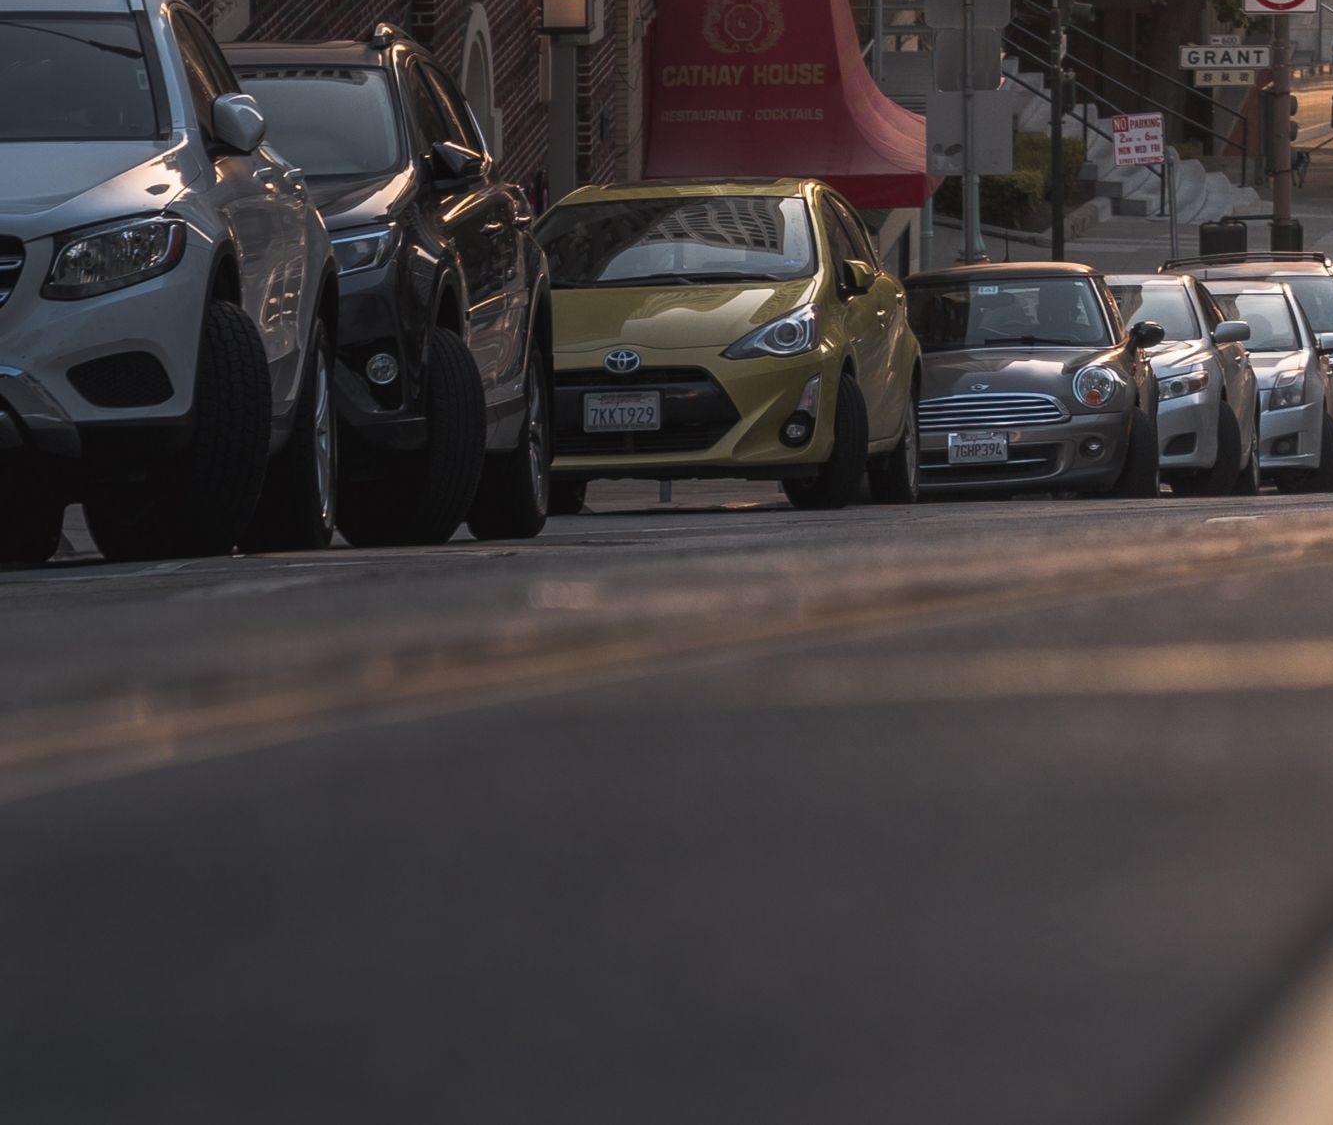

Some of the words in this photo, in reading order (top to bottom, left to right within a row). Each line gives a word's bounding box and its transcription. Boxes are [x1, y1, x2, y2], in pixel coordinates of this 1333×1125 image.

[1187, 50, 1265, 66] GRANT
[662, 65, 745, 87] CATHAY
[752, 63, 825, 86] HOUSE
[660, 109, 744, 122] RESTAURANT
[754, 108, 825, 121] COCKTAILS
[1112, 116, 1128, 132] NO
[1130, 118, 1162, 129] PARKING
[590, 406, 655, 426] 7KKT929
[953, 442, 1002, 458] 7GHP394
